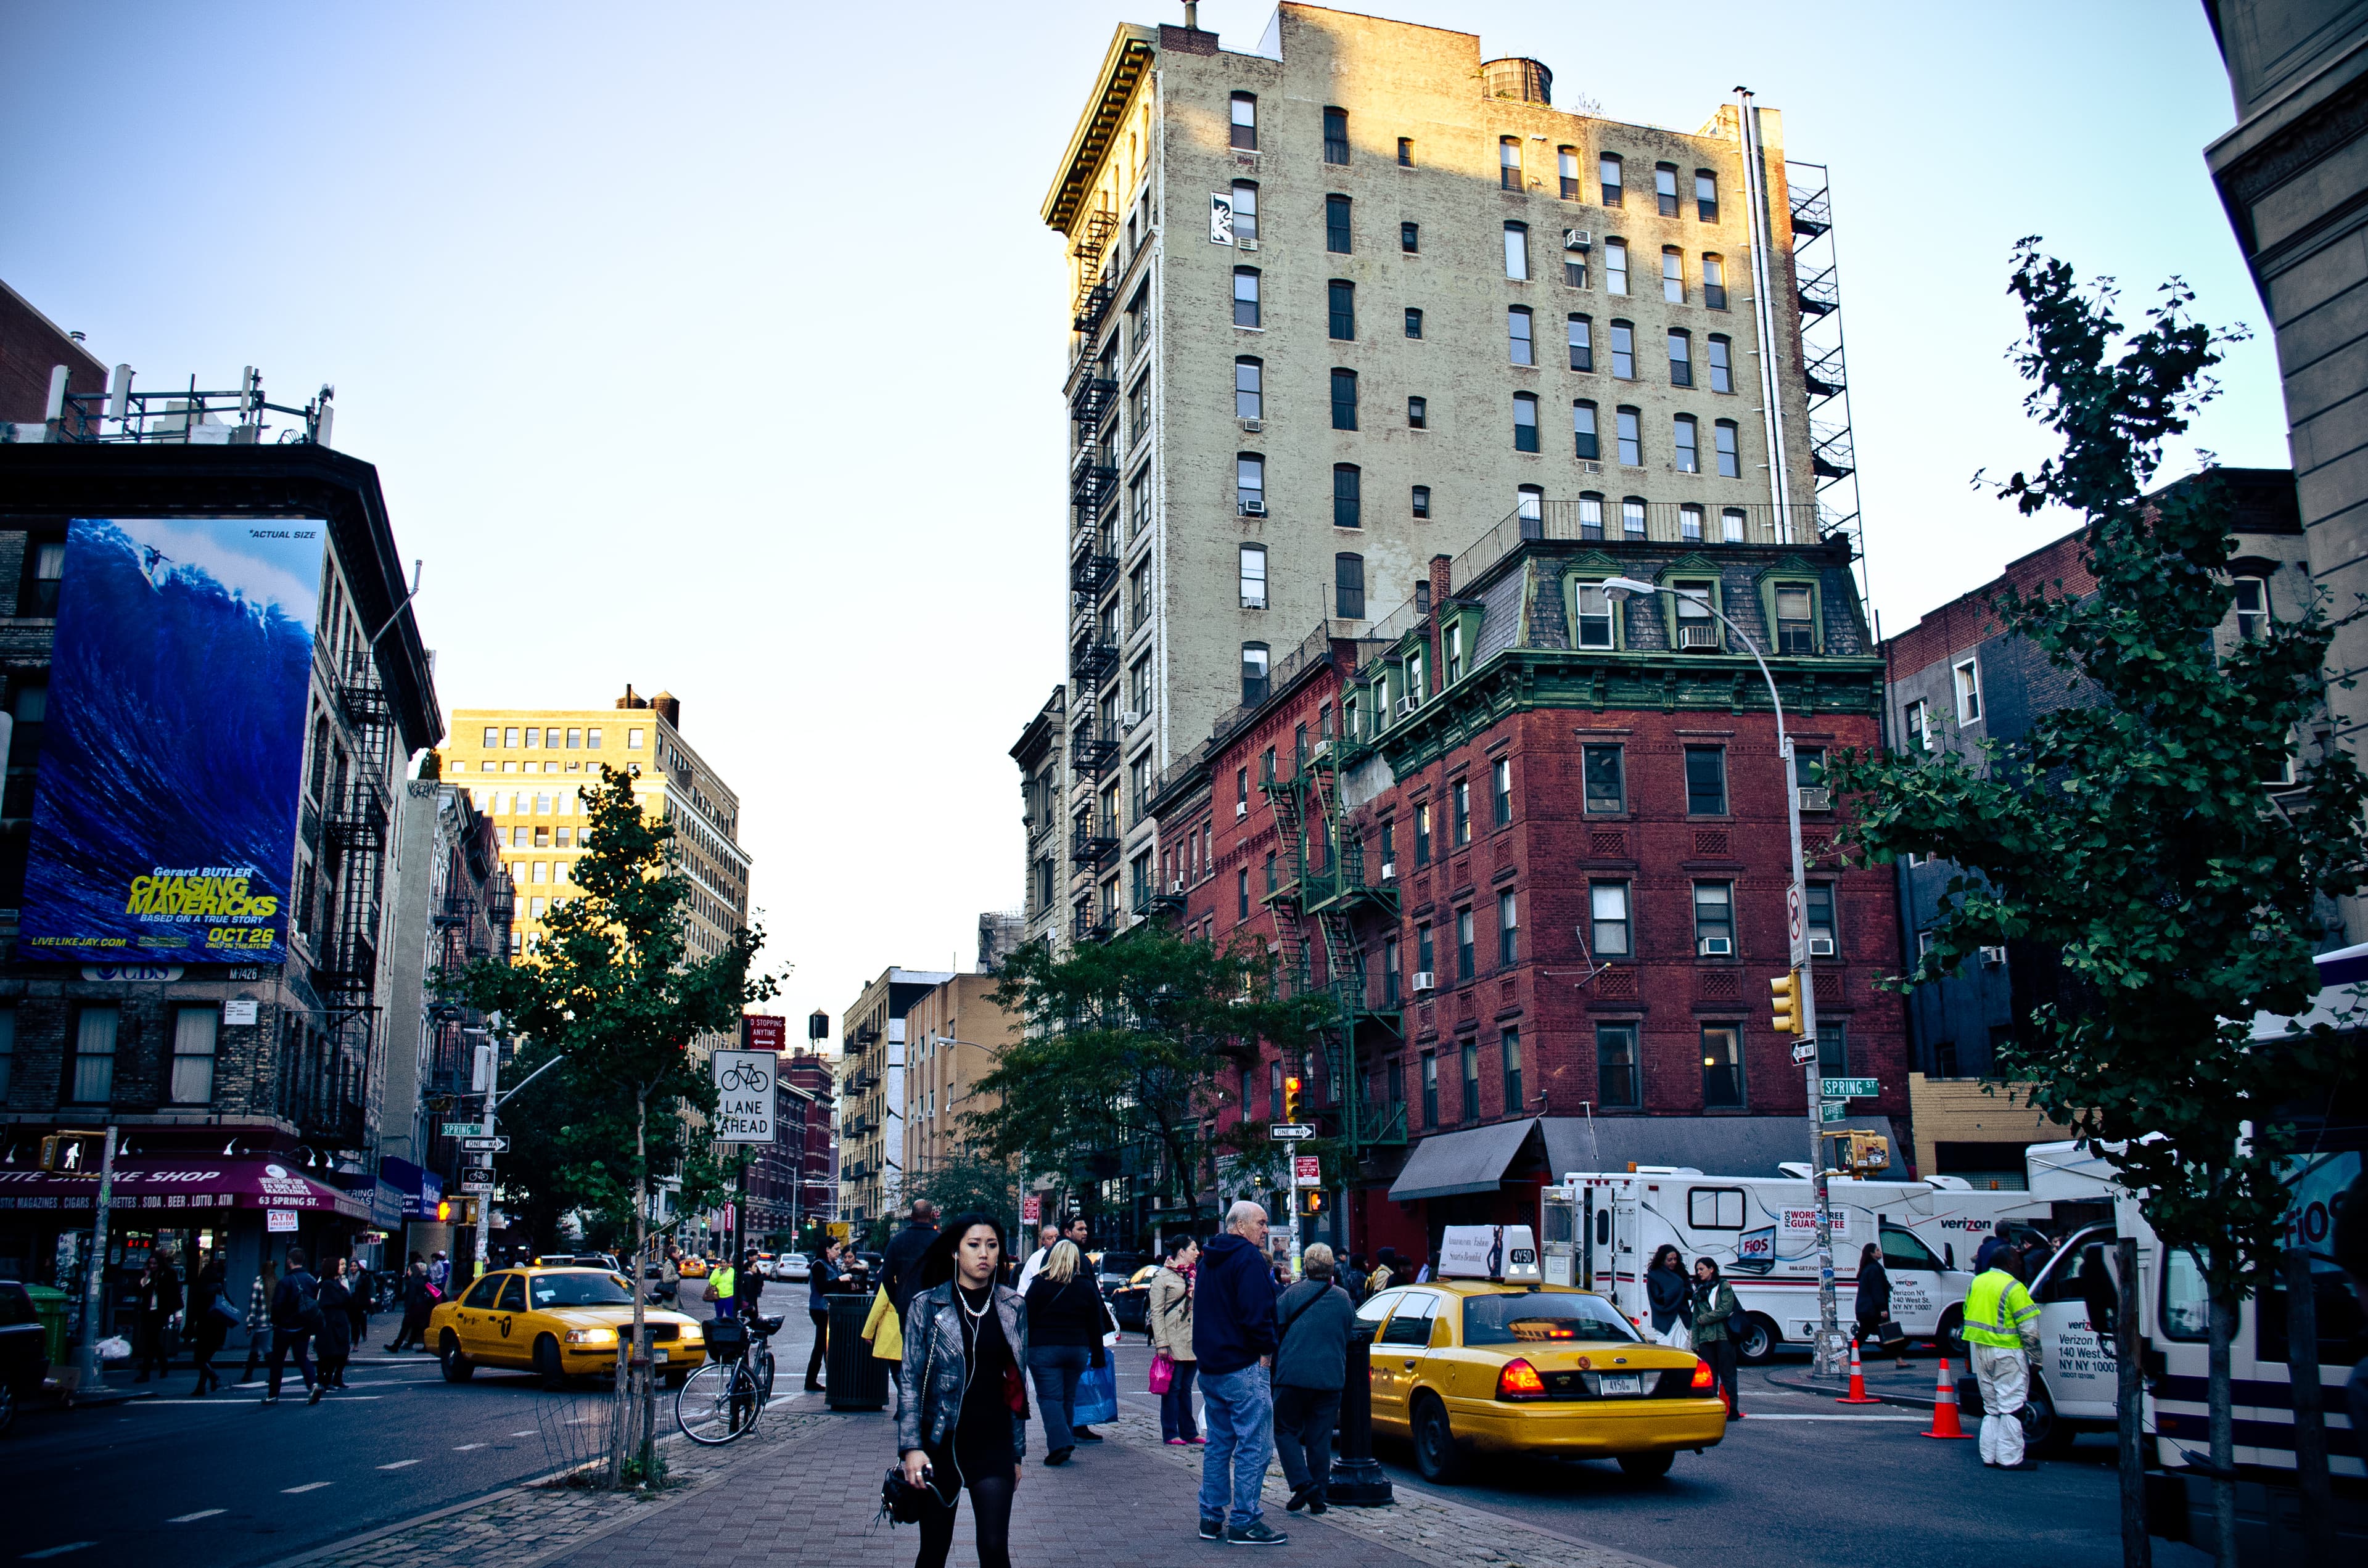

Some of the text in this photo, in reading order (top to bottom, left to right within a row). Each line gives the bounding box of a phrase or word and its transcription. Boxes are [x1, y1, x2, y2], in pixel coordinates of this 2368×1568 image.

[154, 867, 252, 877] Gerard BUTLER
[130, 876, 249, 897] CHASING
[125, 894, 278, 916] MAVERICKS
[140, 914, 173, 922] BASED
[207, 928, 275, 942] OCT 26
[121, 965, 169, 979] CBS
[757, 1019, 782, 1027] STOPPING
[753, 1028, 776, 1036] ANYTIME
[1805, 1045, 1813, 1055] WAY
[1825, 1081, 1863, 1094] SPRING
[726, 1101, 762, 1114] LANE
[444, 1125, 471, 1135] SPRING
[721, 1119, 768, 1133] AHEAD
[145, 1172, 221, 1181] SHOP
[17, 1197, 58, 1208] MAGAZINES
[64, 1197, 89, 1208] CIGARS
[142, 1196, 161, 1207] SODA
[168, 1196, 185, 1207] BEER
[192, 1195, 212, 1207] LOTTO
[218, 1194, 233, 1206] ATM
[259, 1196, 319, 1206] 63 SPRING ST.
[1791, 1220, 1844, 1229] GUARTEE
[1941, 1218, 1991, 1231] verizon
[1744, 1239, 1768, 1252] FiOS
[1513, 1250, 1532, 1262] 4Y50
[2068, 1320, 2092, 1331] veriz
[2059, 1334, 2092, 1345] Verizon
[2059, 1347, 2074, 1357] 140
[2077, 1347, 2100, 1359] West
[2059, 1359, 2073, 1369] NY
[2075, 1360, 2089, 1370] NY
